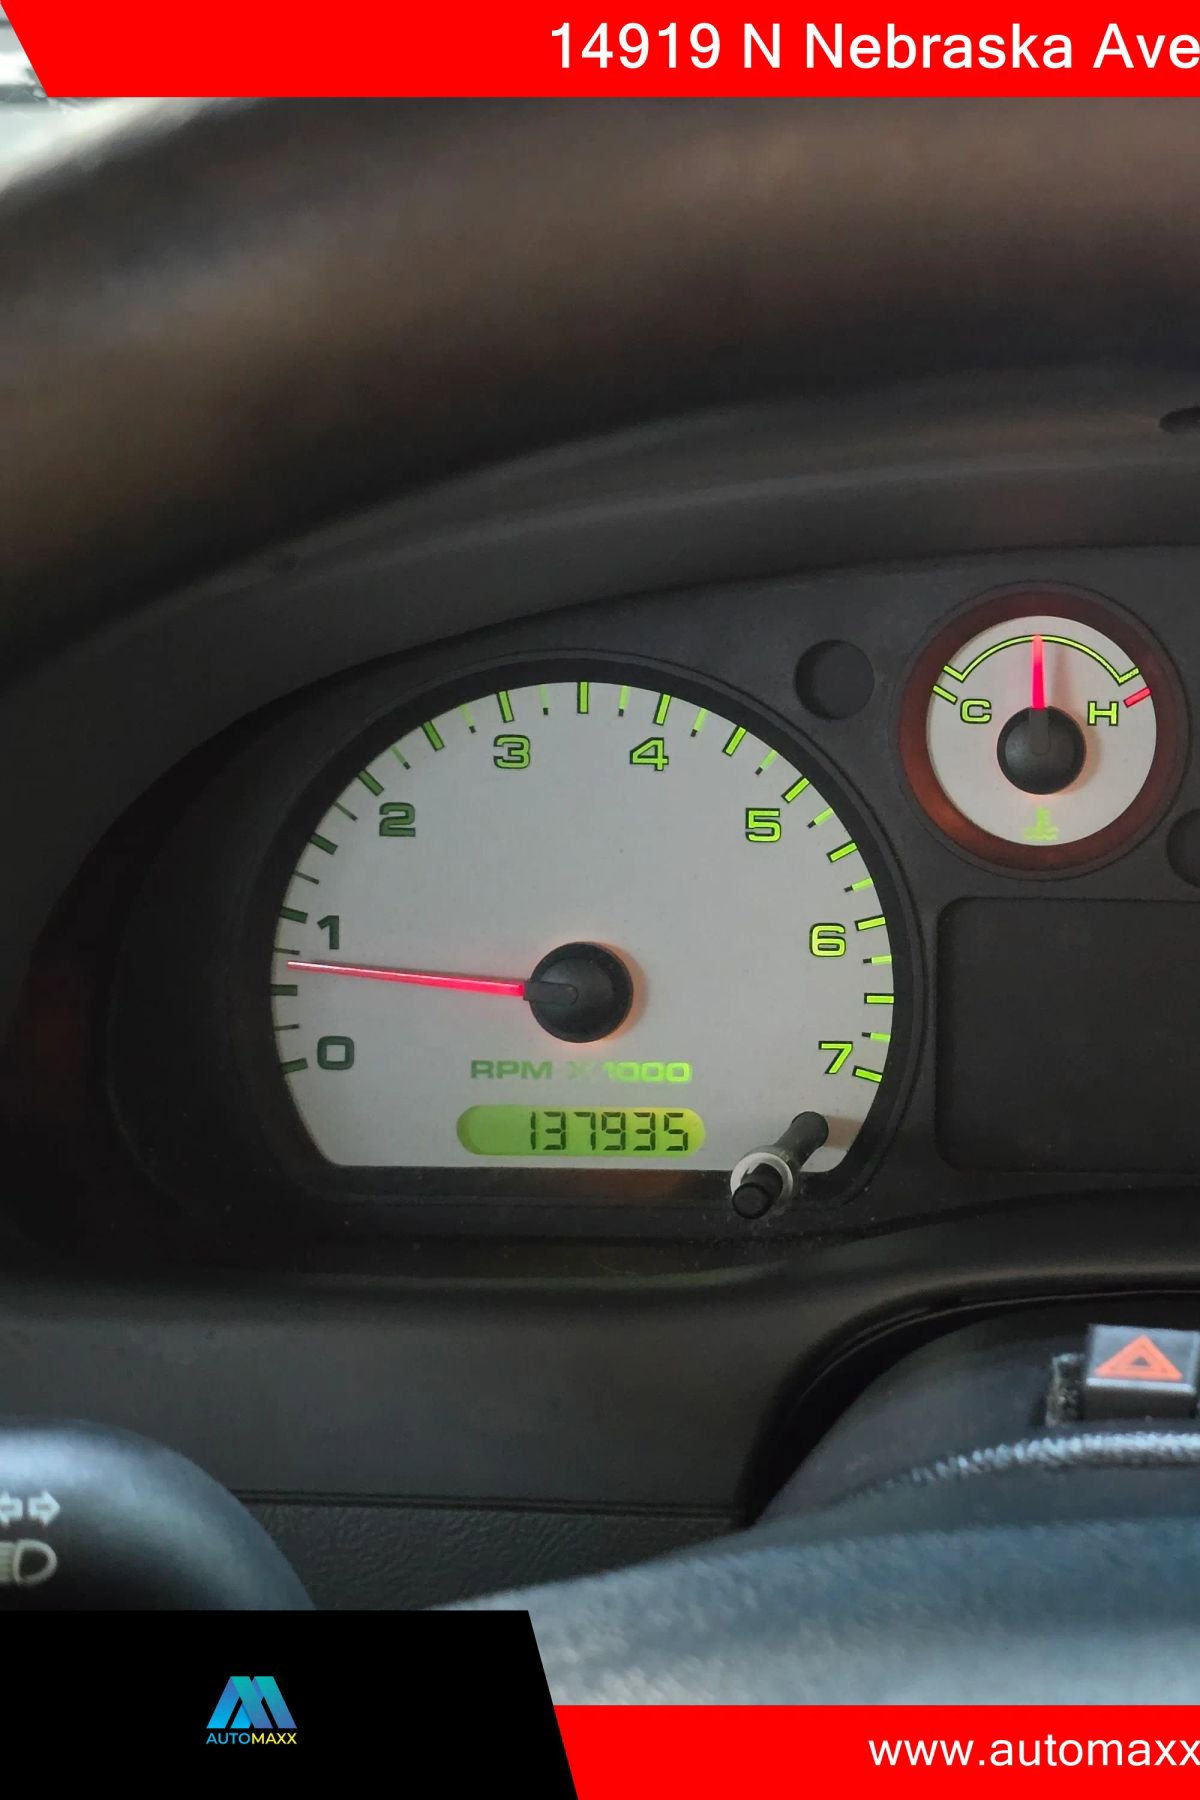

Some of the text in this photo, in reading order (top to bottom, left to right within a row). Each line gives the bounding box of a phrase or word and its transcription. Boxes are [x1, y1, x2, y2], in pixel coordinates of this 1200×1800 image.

[959, 698, 992, 725] C
[1087, 700, 1119, 726] H
[493, 734, 531, 769] 3
[629, 736, 670, 771] 4
[378, 802, 417, 838] 2
[744, 807, 783, 843] 5
[317, 914, 341, 950] 1
[809, 922, 847, 959] 6
[316, 1035, 355, 1071] 0
[817, 1040, 854, 1075] 7
[470, 1060, 553, 1080] RPM
[603, 1060, 692, 1083] 1000
[530, 1111, 689, 1152] 137935
